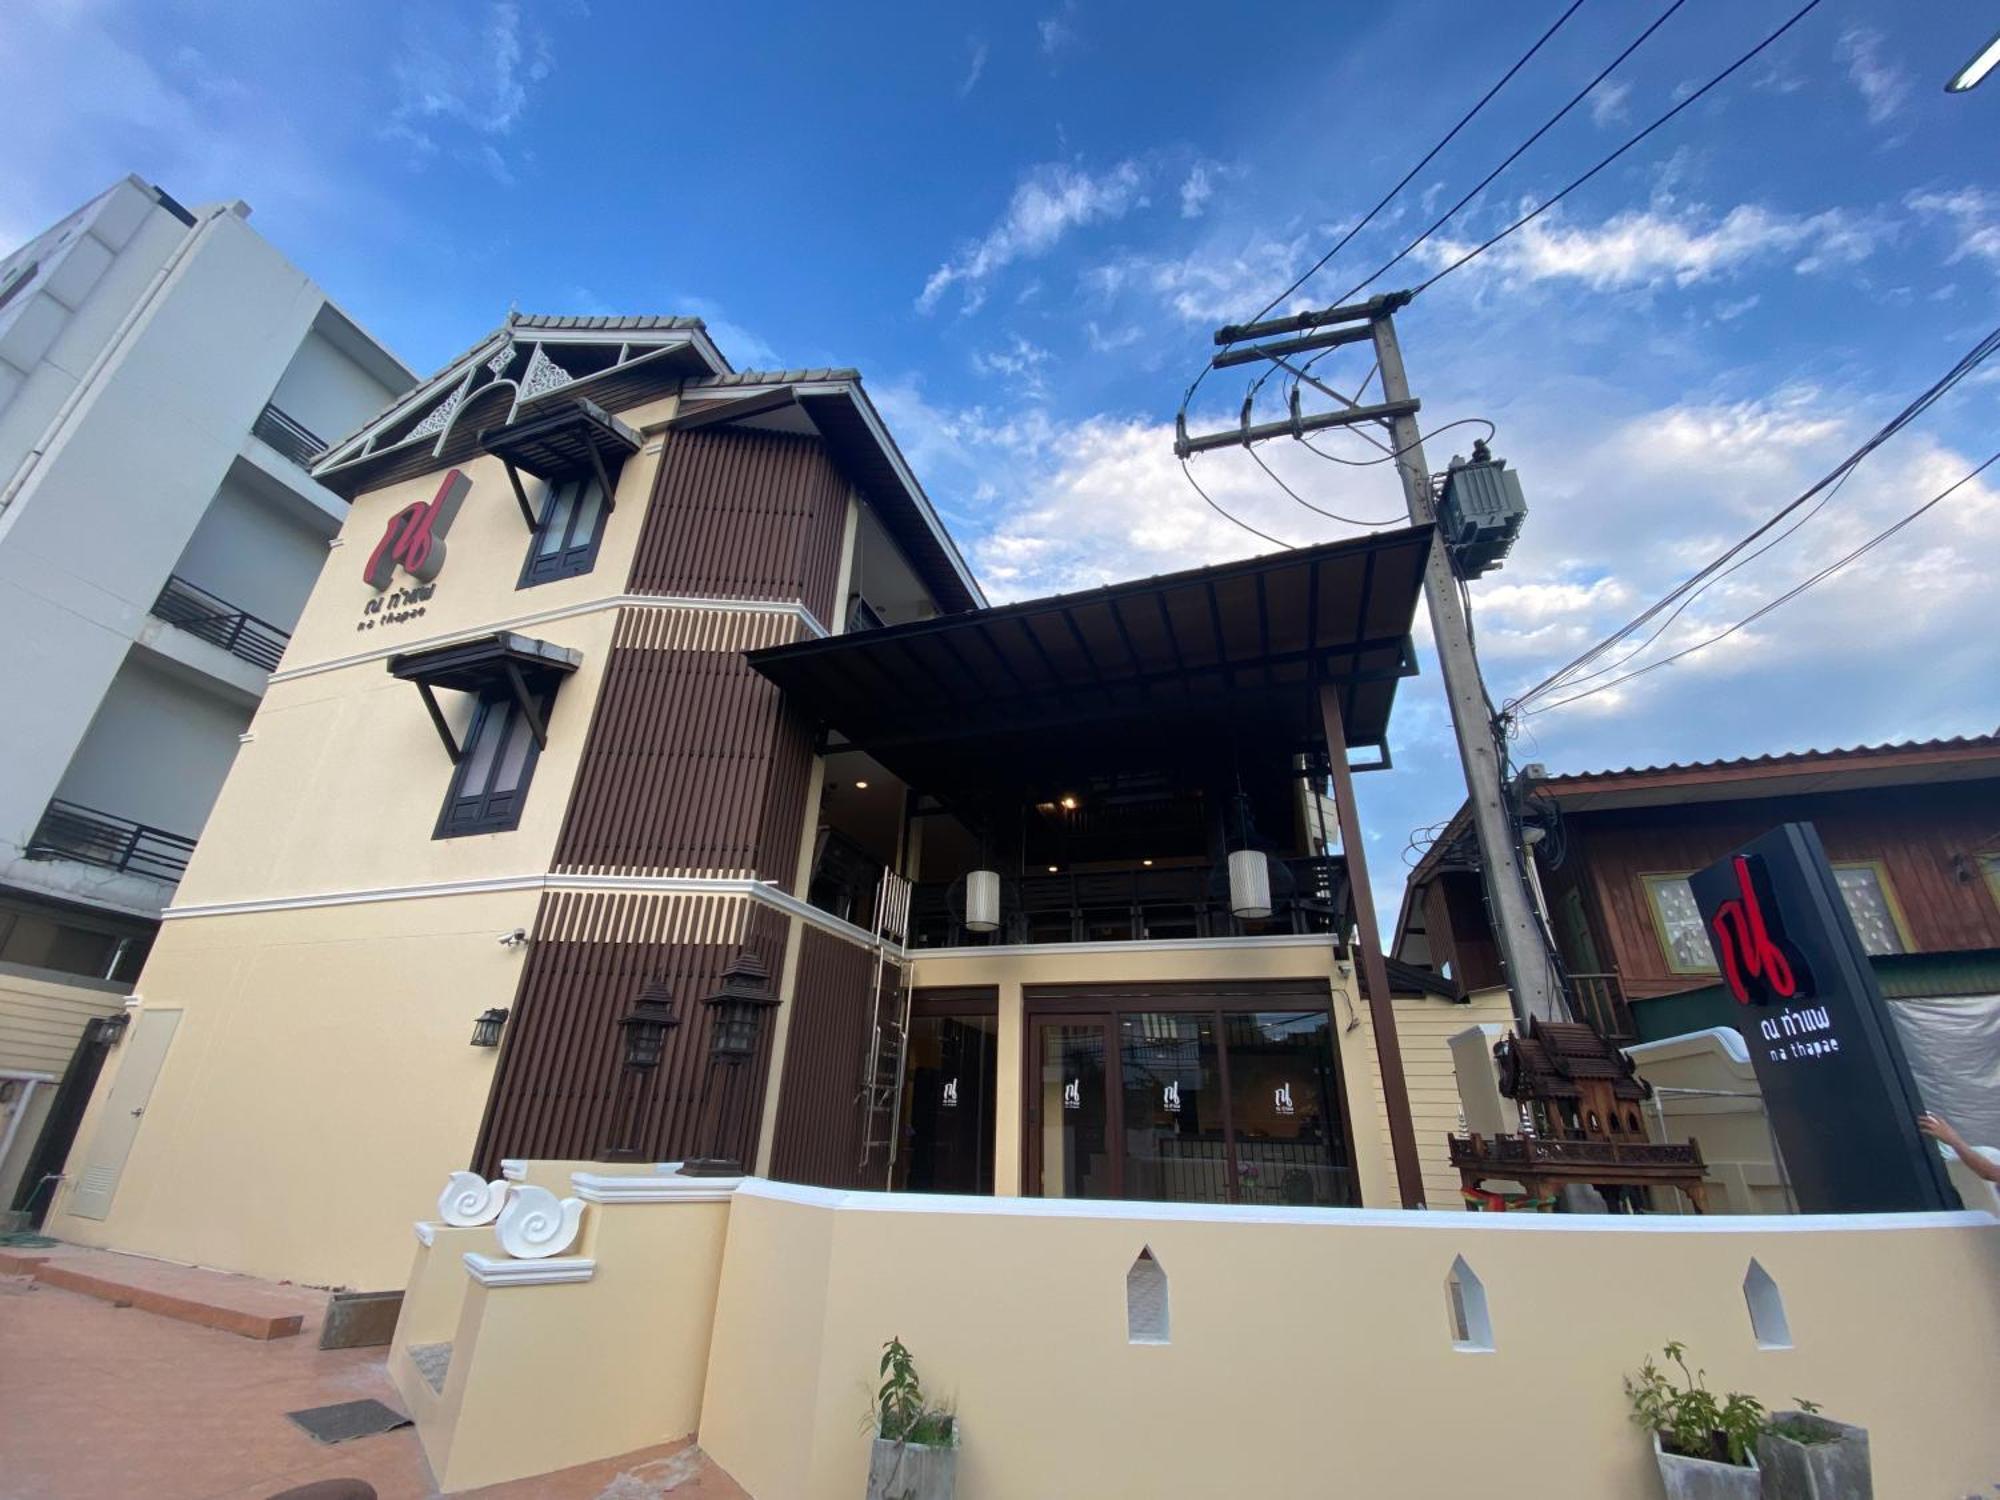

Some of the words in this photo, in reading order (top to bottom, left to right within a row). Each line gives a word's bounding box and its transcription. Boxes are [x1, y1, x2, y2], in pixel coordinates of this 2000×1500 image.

[357, 619, 375, 632] na
[1761, 1018, 1780, 1040] ณ
[1770, 1048, 1787, 1061] na
[1790, 1038, 1839, 1058] thapae
